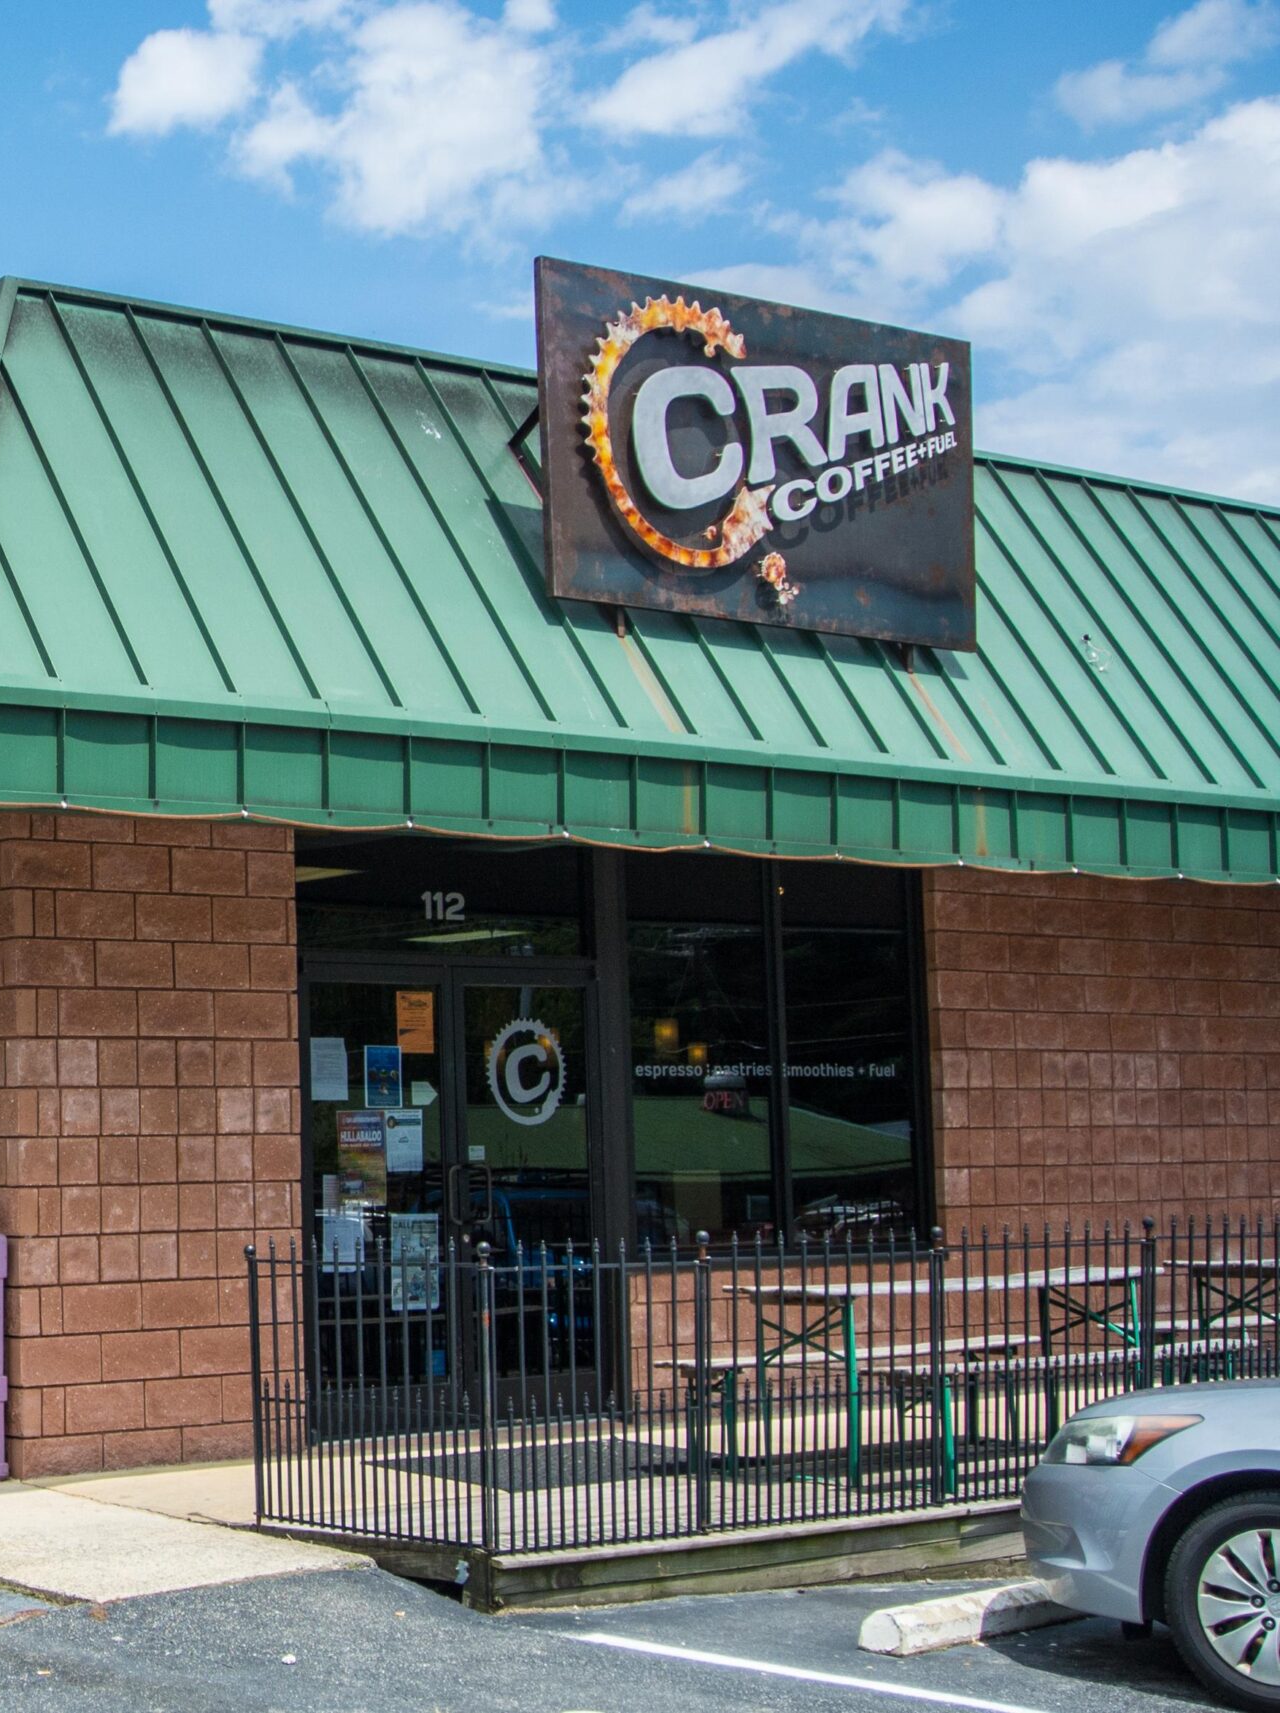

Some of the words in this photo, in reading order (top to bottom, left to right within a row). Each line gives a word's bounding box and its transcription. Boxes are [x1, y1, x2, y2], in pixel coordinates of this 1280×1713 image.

[633, 362, 956, 510] CRANK
[770, 431, 958, 522] COFFEE+FUEL
[421, 892, 465, 921] 112
[505, 1043, 550, 1103] C
[635, 1064, 703, 1080] espresso
[869, 1063, 896, 1077] fuel
[704, 1091, 747, 1110] OPEN
